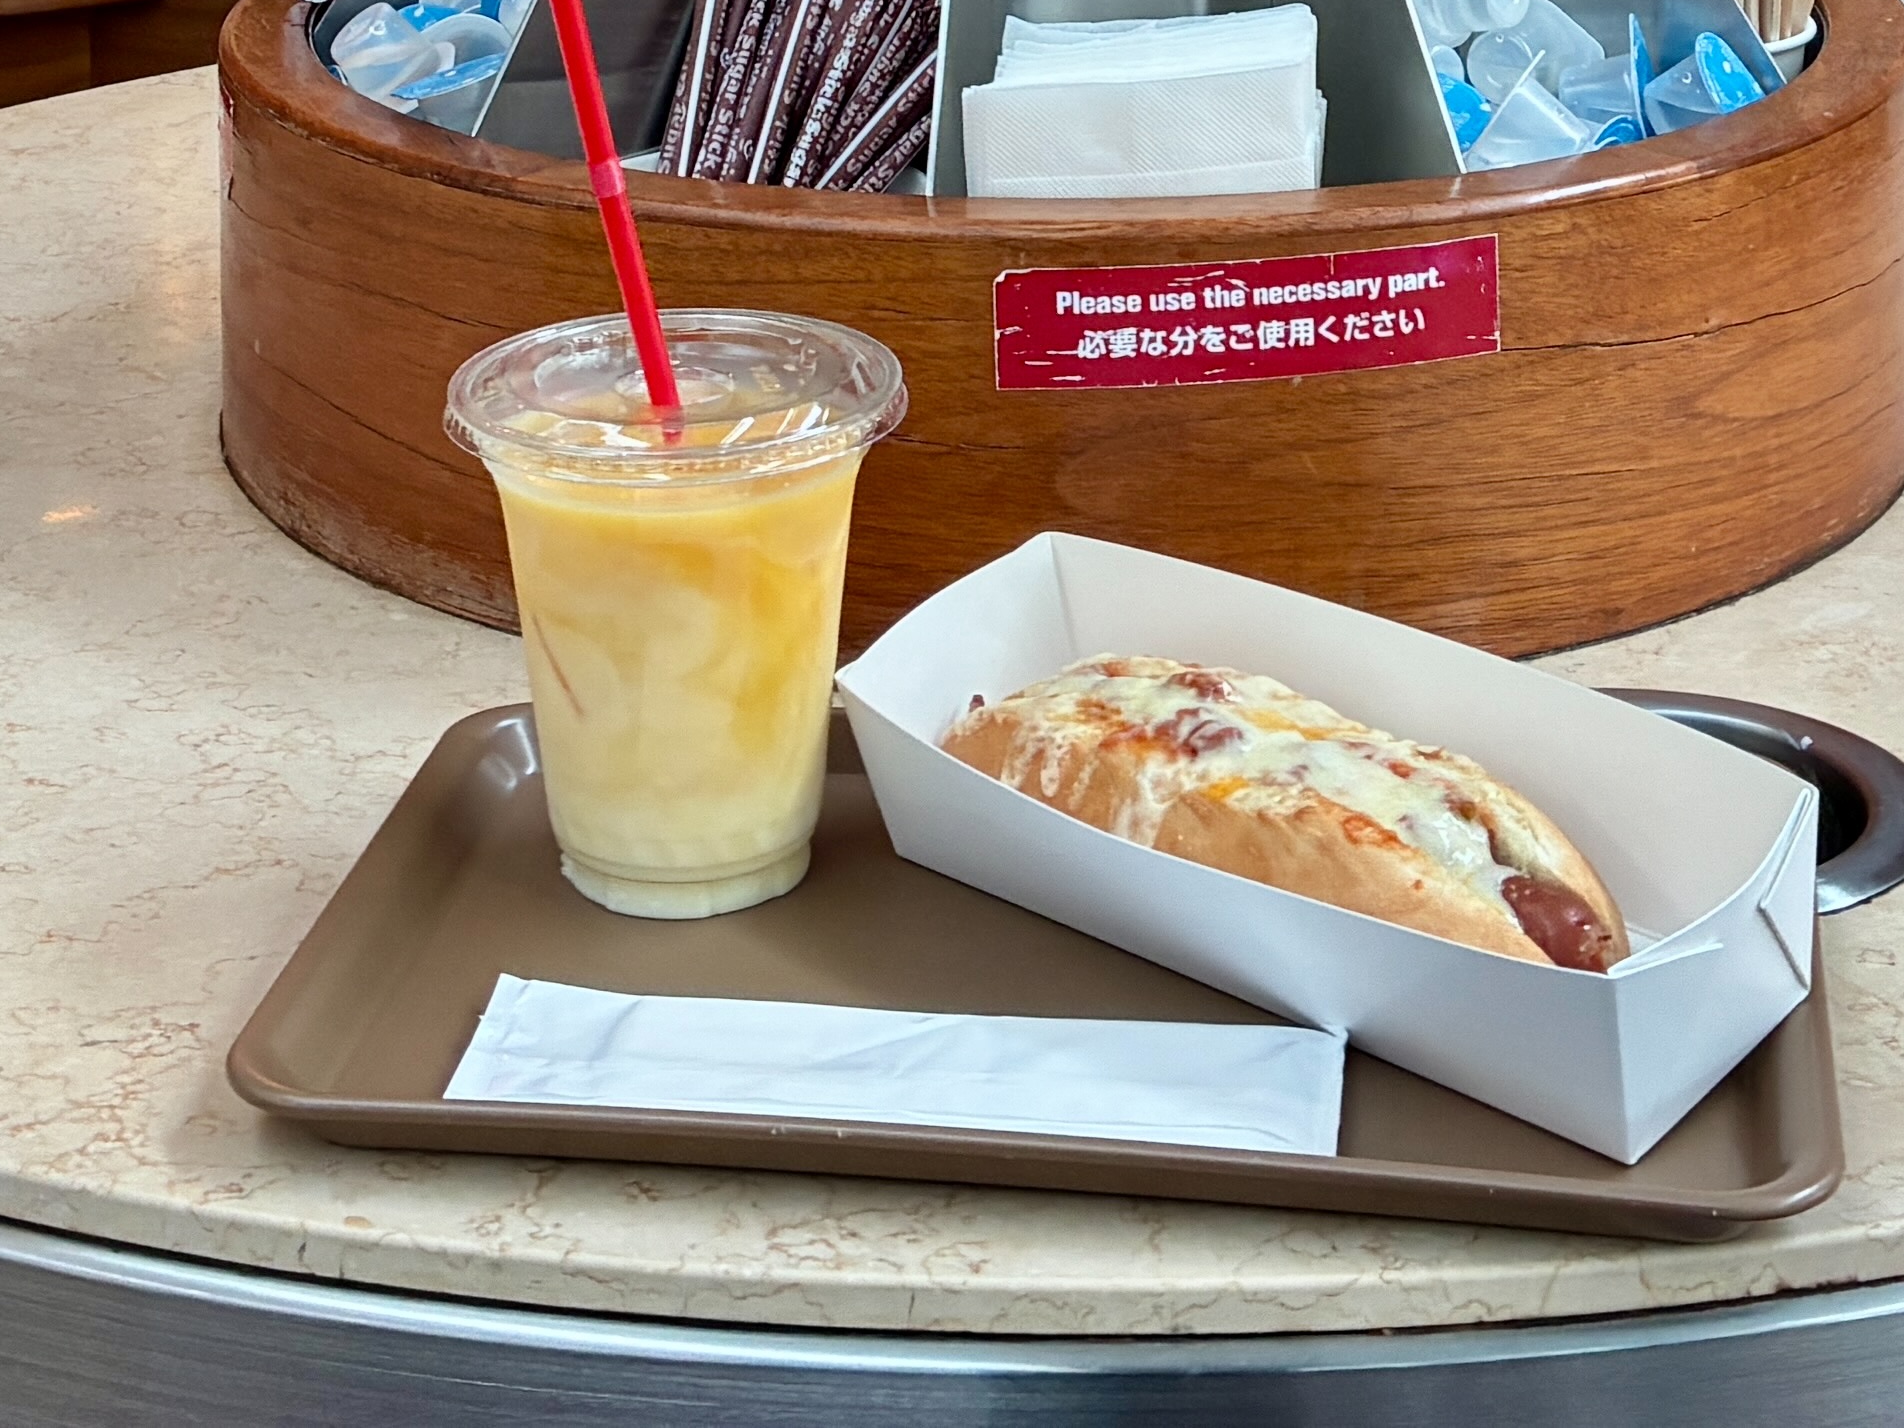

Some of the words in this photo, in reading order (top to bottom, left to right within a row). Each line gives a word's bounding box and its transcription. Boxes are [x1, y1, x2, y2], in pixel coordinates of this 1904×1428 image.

[1056, 289, 1142, 316] Please
[1150, 291, 1196, 313] use
[1204, 283, 1245, 309] the
[1253, 277, 1382, 307] necessary
[1388, 266, 1446, 296] part.
[1077, 306, 1426, 359] 必要な分をご使用ください
